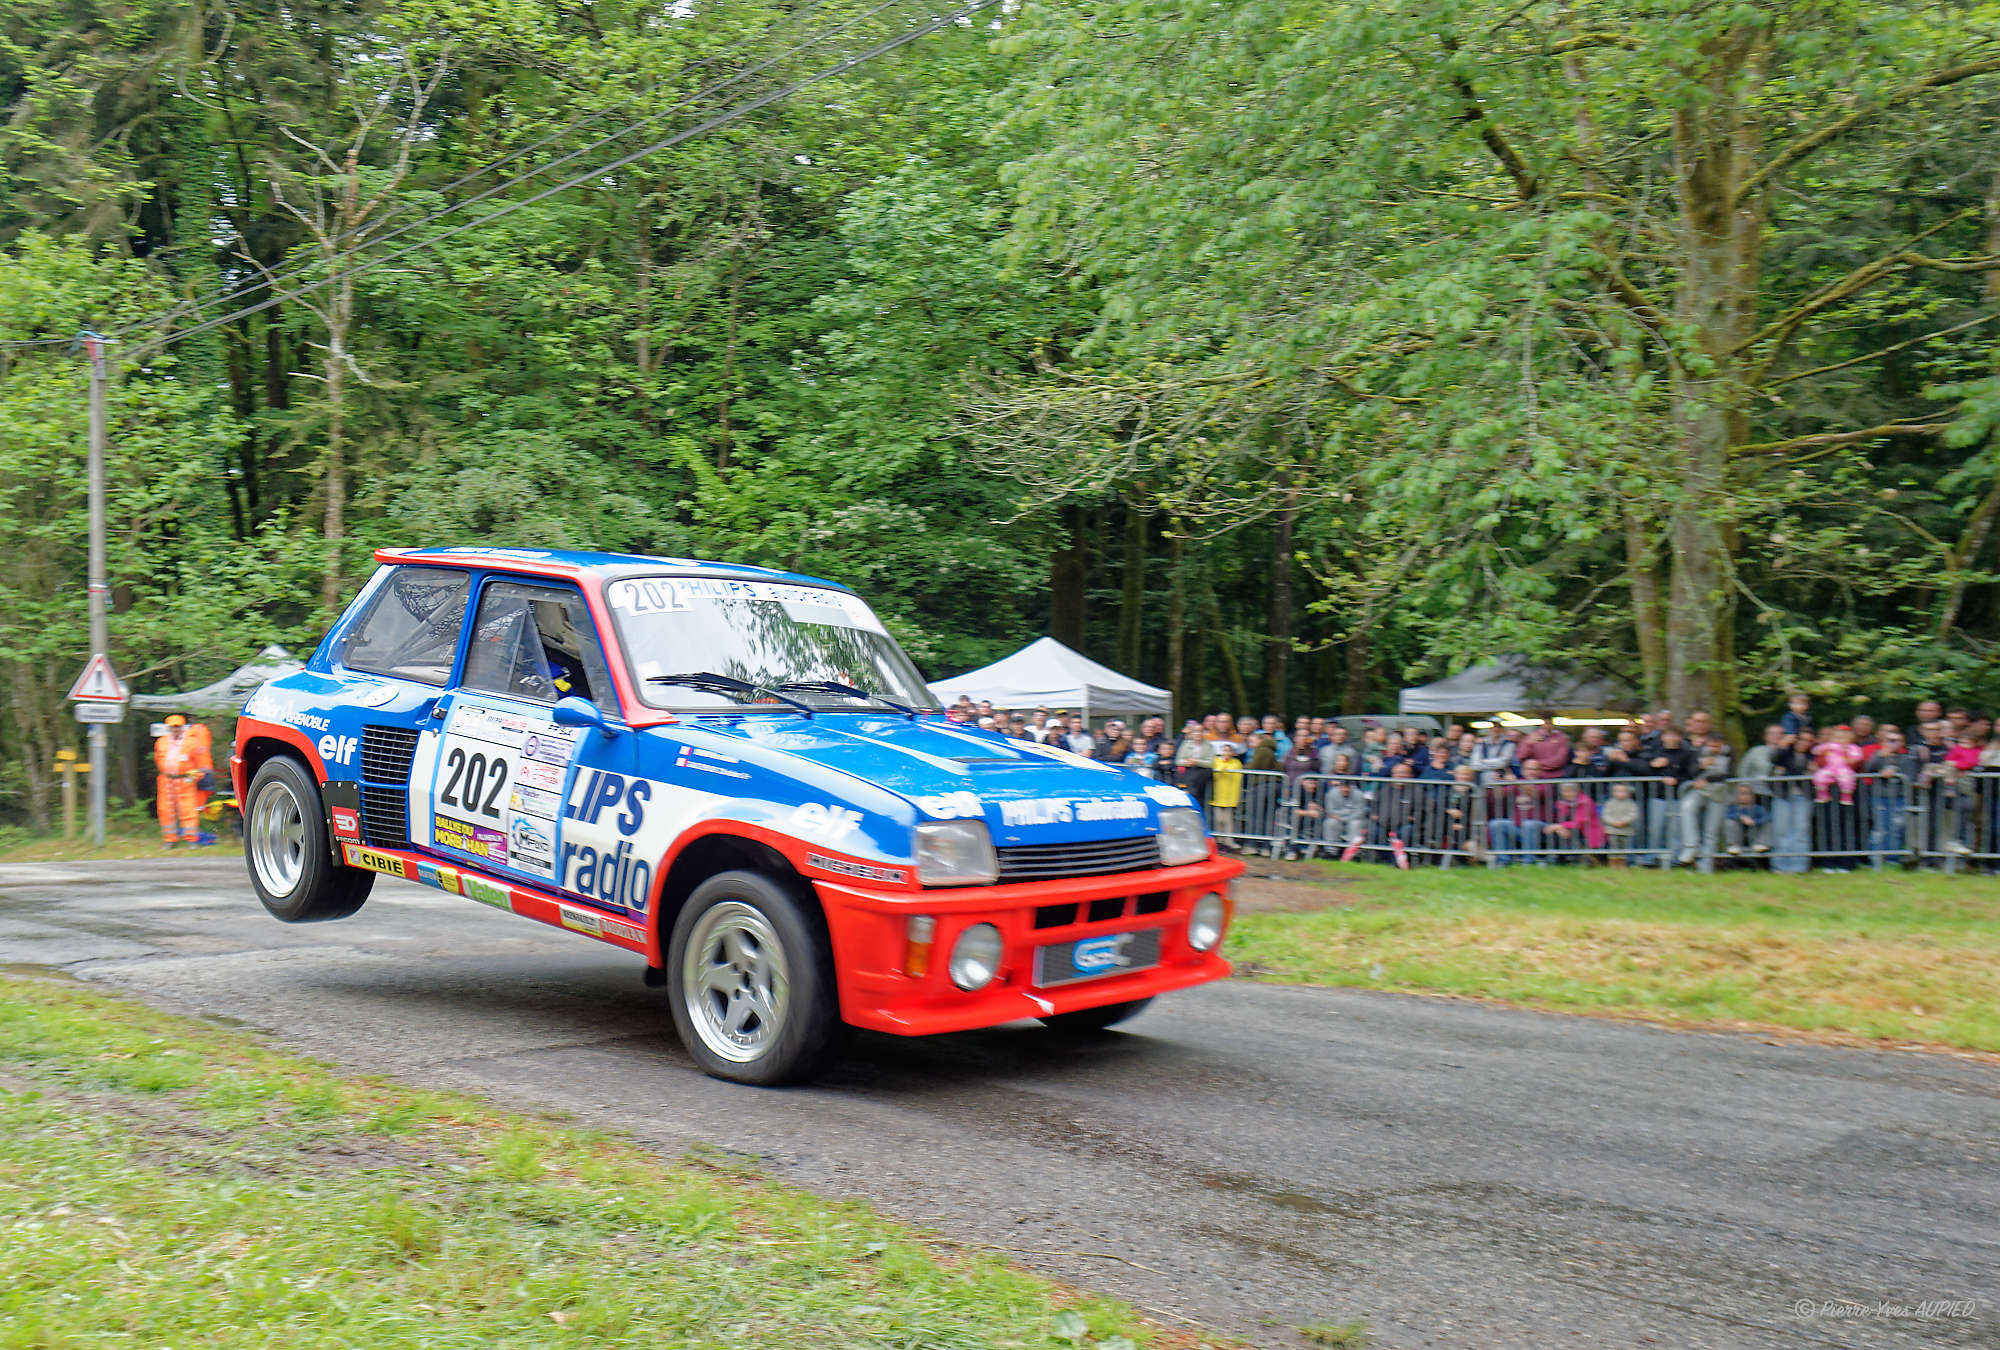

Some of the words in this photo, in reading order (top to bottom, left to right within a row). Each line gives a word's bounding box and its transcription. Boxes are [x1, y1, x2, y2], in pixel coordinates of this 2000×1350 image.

[624, 581, 684, 612] 202
[318, 734, 359, 766] elf
[440, 748, 508, 819] 202
[789, 802, 865, 840] elf
[562, 839, 650, 910] radio
